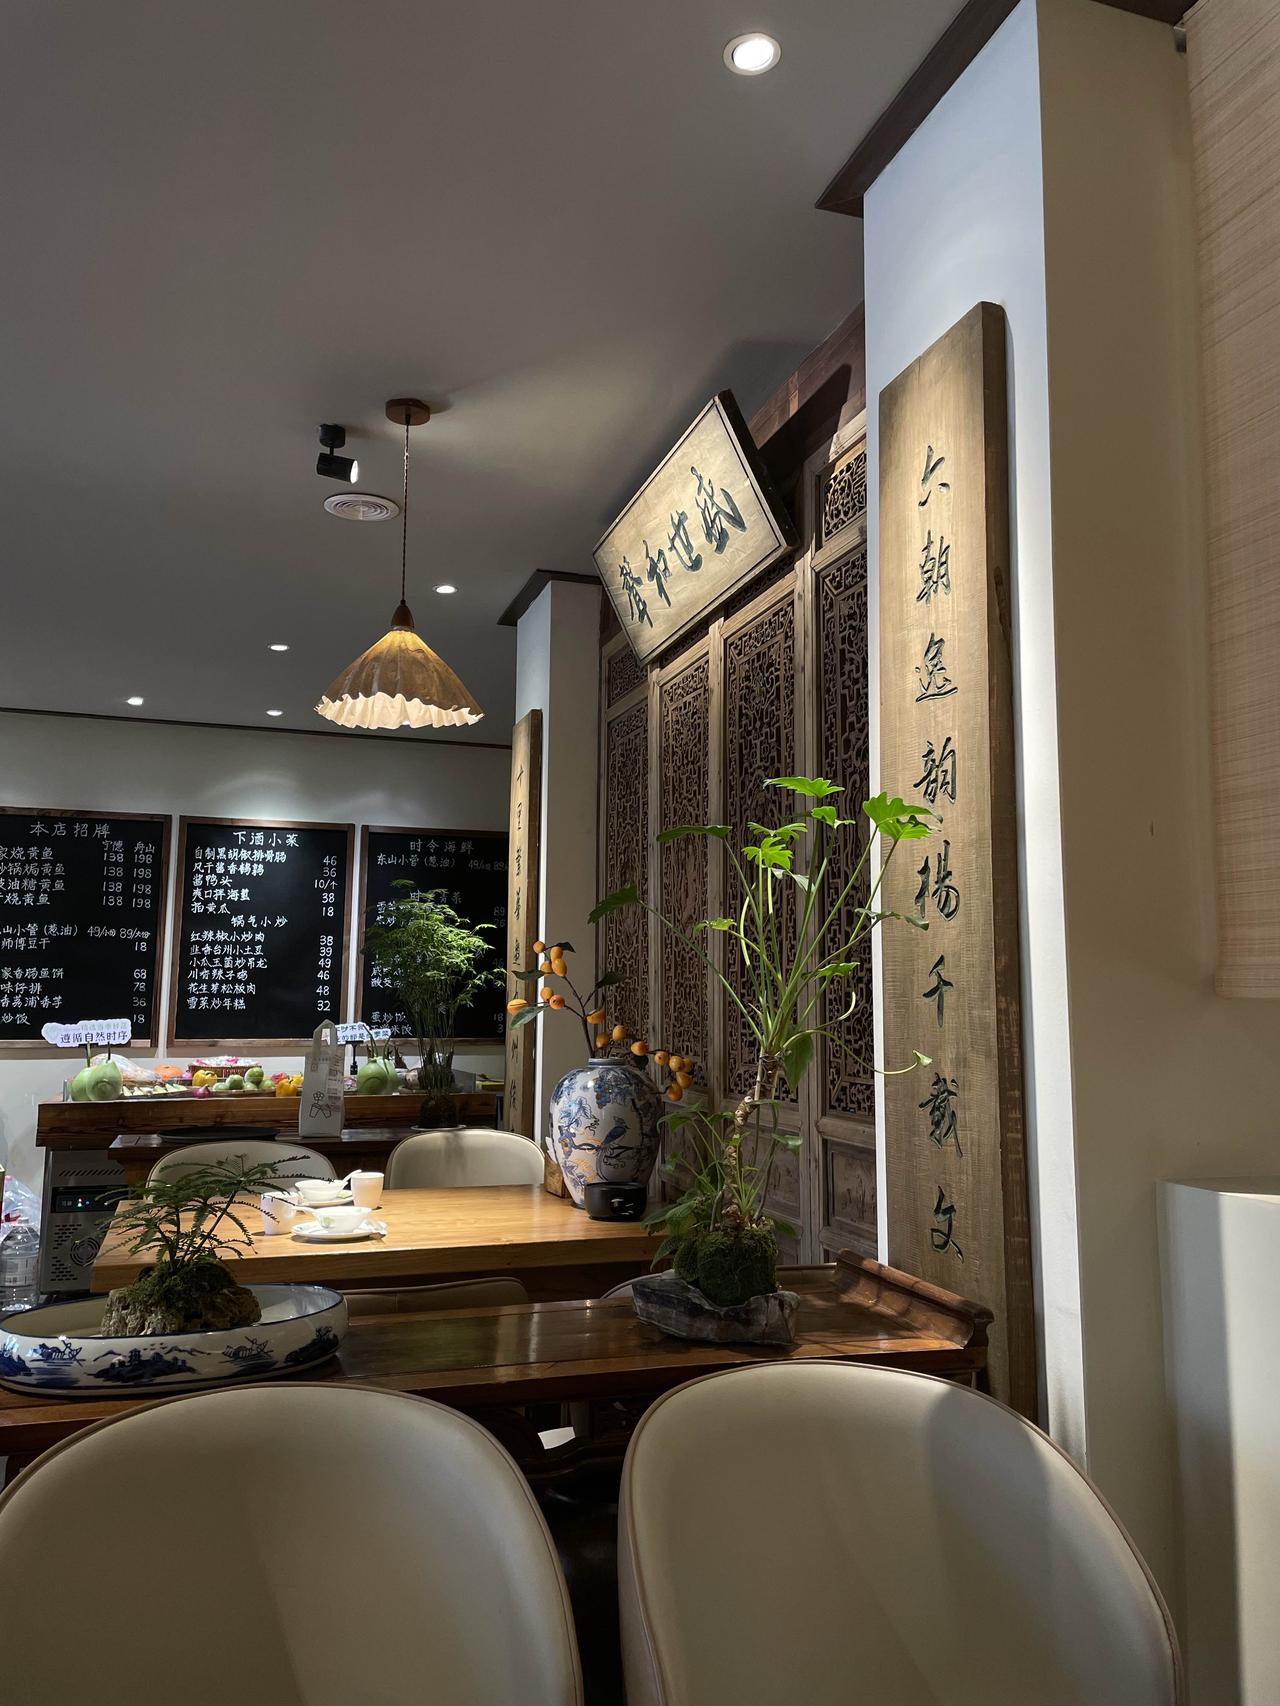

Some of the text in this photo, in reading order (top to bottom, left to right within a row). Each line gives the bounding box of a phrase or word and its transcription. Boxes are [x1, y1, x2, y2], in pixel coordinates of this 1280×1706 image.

[29, 821, 111, 839] 本店招牌
[233, 831, 299, 847] 下酒小菜
[102, 840, 156, 854] 宁德 舟山
[409, 839, 474, 855] 时令海鲜
[103, 852, 125, 863] 138
[134, 854, 153, 865] 198
[194, 846, 337, 866] 自制黑胡椒排骨肠 46
[103, 866, 125, 878] 138
[133, 868, 153, 879] 198
[323, 868, 337, 878] 36
[102, 881, 123, 893] 138
[132, 883, 152, 895] 198
[192, 874, 338, 890] 酱鸭头 10/个
[102, 895, 123, 907] 138
[132, 898, 151, 909] 198
[191, 887, 335, 904] 爽口拌海蜇 38
[190, 902, 334, 917] 拍黄瓜 18
[231, 915, 288, 928] 锅气小炒
[0, 924, 78, 937] 山小管(葱油)
[1, 937, 147, 952] 师傅豆干 18
[190, 930, 334, 946] 红辣椒小炒肉 38
[319, 946, 333, 957] 39
[318, 958, 331, 969] 49
[133, 968, 147, 980] 68
[187, 969, 330, 981] 川香辣子鸡 46
[0, 981, 146, 995] 味仔排 78
[187, 983, 330, 996] 花生芽松板肉 48
[132, 997, 147, 1007] 36
[187, 996, 331, 1011] 雪菜炒年糕 32
[0, 1012, 145, 1026] 炒饭 18
[371, 1011, 406, 1024] 蛋炒饭
[60, 1030, 128, 1044] 遵循自然时序
